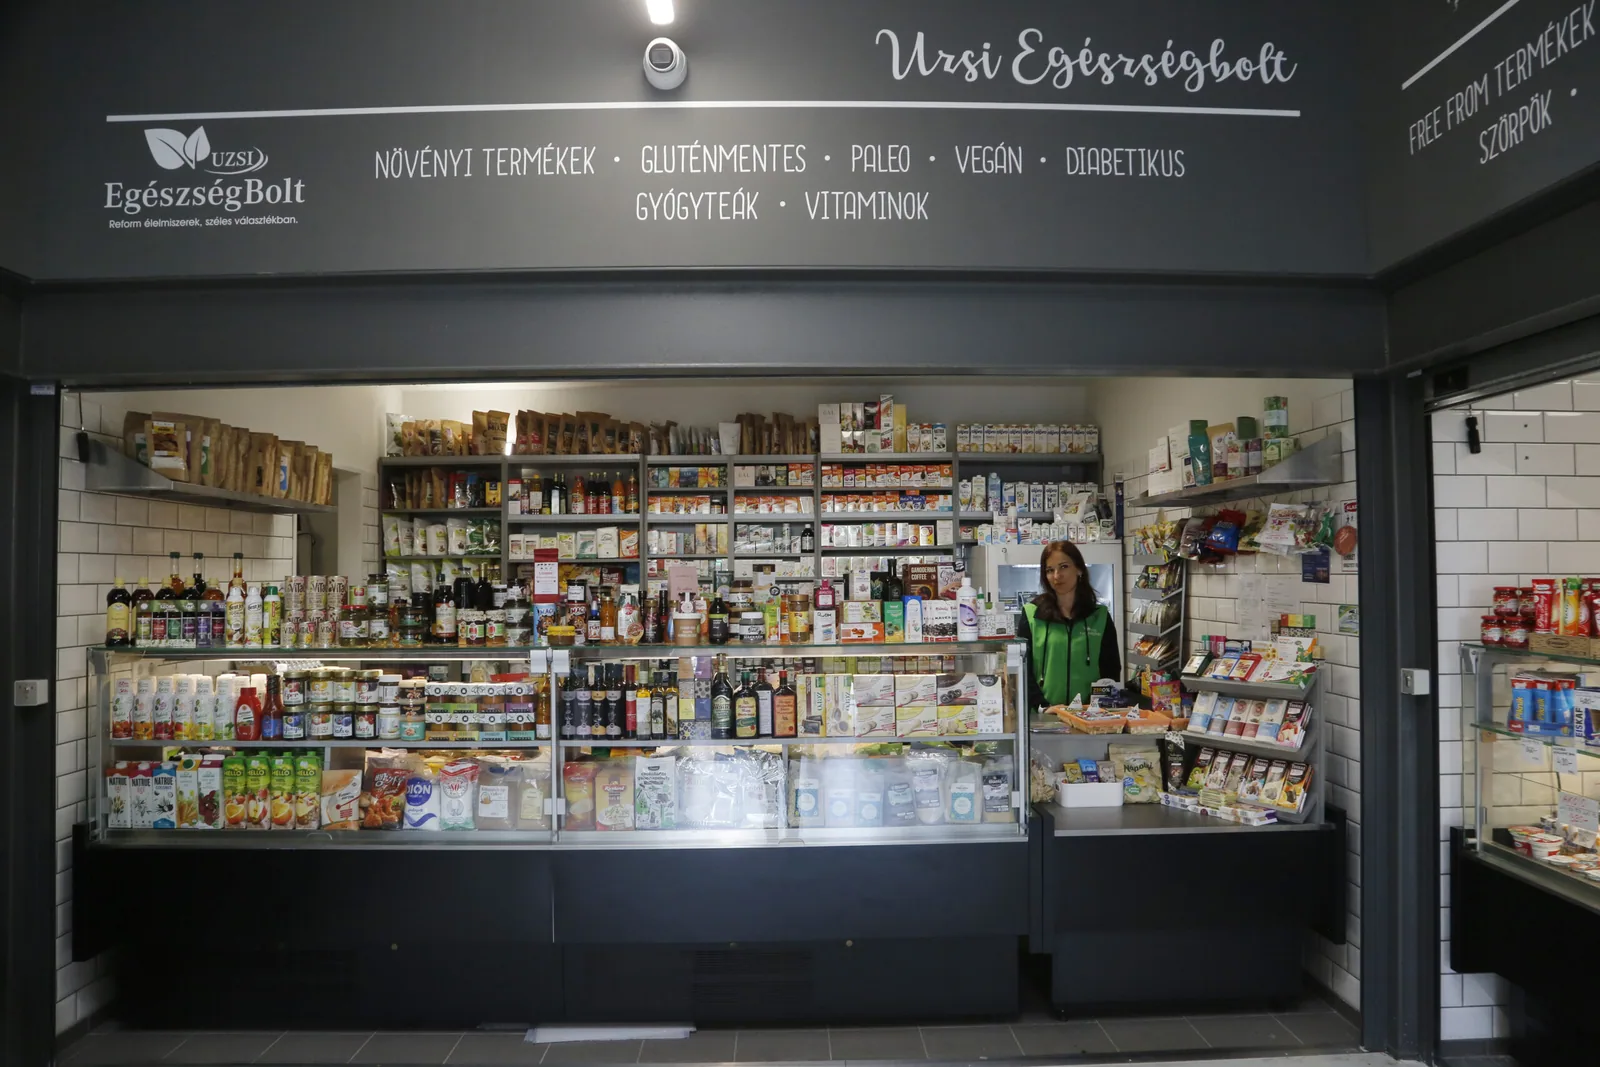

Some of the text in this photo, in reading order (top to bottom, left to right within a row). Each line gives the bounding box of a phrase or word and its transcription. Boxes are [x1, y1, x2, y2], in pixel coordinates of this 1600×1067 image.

[1409, 0, 1596, 156] FREE FROM TERMÉKEK
[1479, 89, 1552, 165] SZÖRPÖK
[211, 151, 254, 167] UZSI
[375, 139, 1185, 179] NÖVÉNYI TERMÉKEK GLUTÉNMENTES PALEO VEGÁN DIABETIKUS
[103, 177, 306, 215] EgészségBolt
[636, 187, 929, 221] GYÓGYTEÁK VITAMINOK
[109, 214, 299, 229] Reform élelmiszerek, széles választékban.
[109, 777, 127, 786] NATRUE
[131, 778, 151, 787] NATRUE
[154, 776, 175, 786] NATRUE
